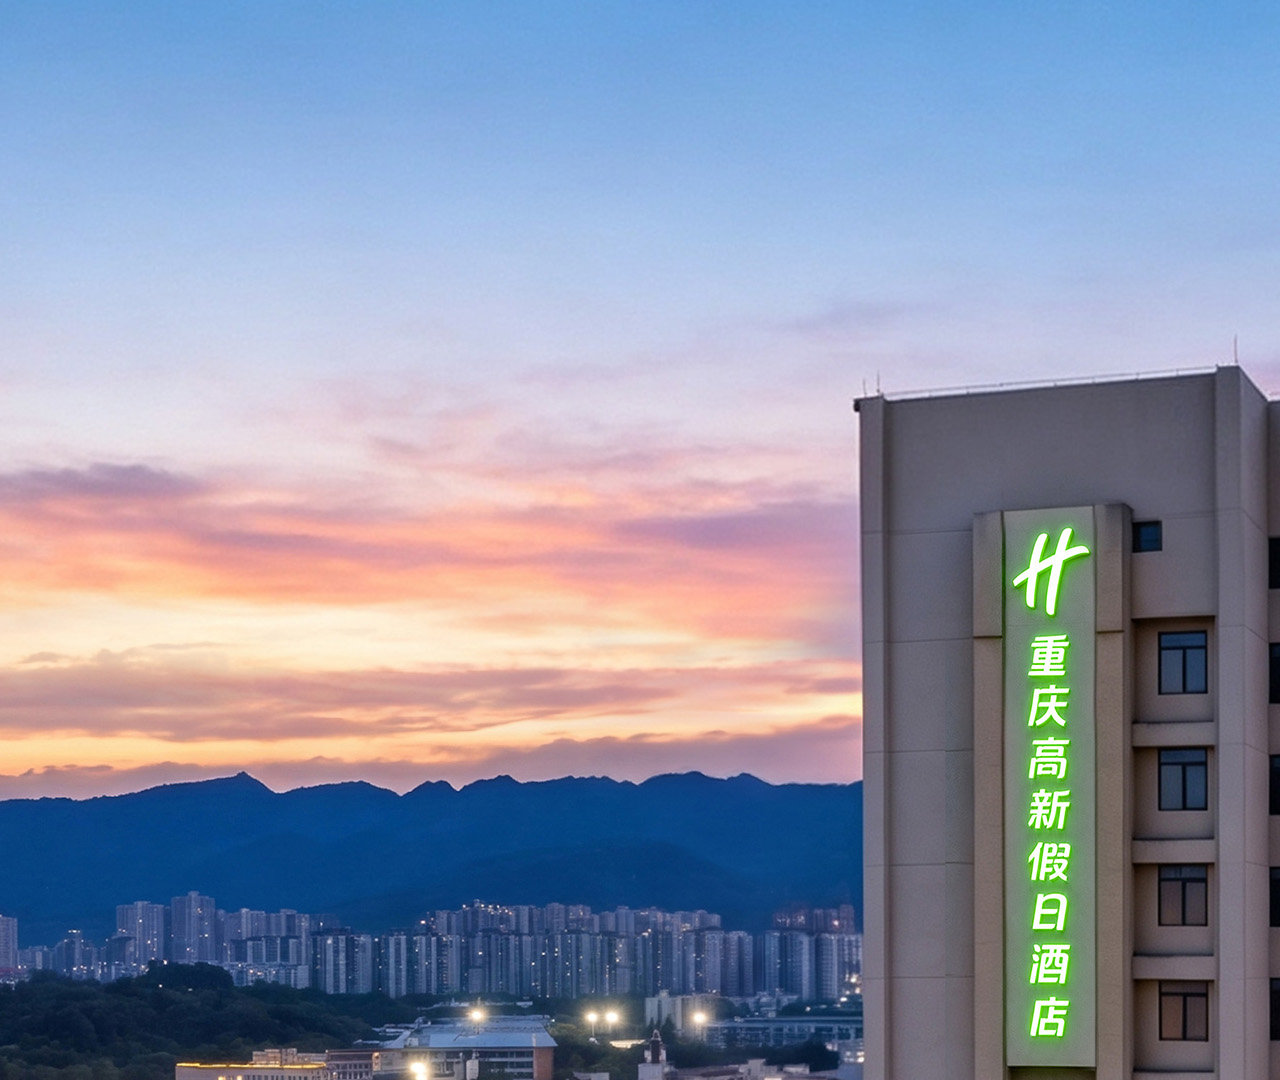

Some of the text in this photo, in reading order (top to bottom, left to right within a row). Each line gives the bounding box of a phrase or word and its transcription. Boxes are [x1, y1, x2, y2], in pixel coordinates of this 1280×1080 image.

[1027, 634, 1071, 1037] 重庆高新假日酒店
